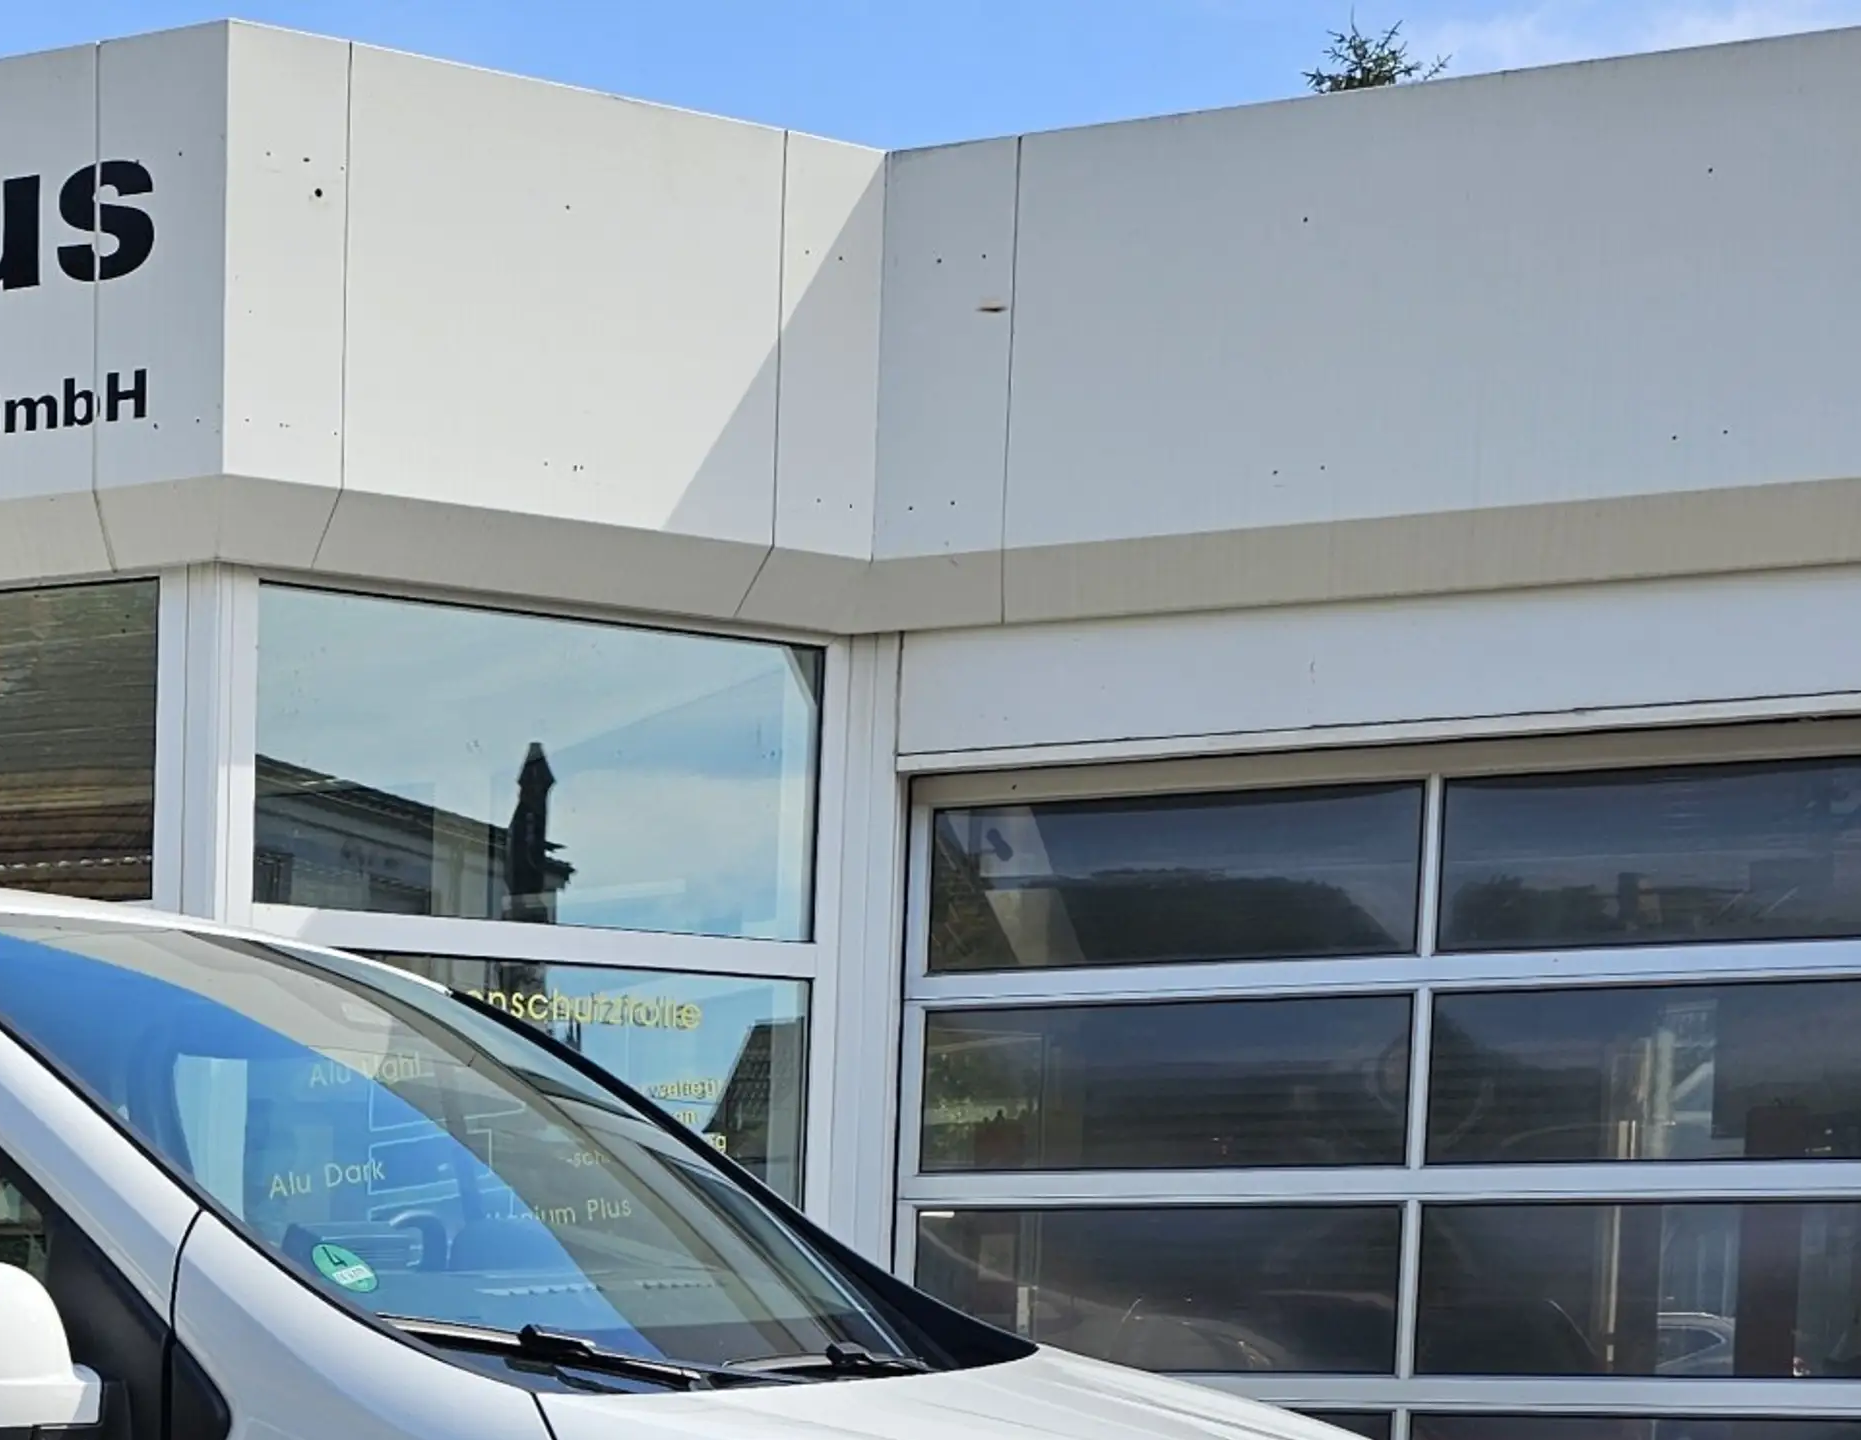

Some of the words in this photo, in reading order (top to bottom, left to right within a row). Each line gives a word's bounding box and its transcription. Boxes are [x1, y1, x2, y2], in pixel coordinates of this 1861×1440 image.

[309, 1058, 352, 1088] Alu
[269, 1171, 312, 1200] Alu
[324, 1157, 386, 1188] Dark
[587, 1197, 632, 1221] Plus
